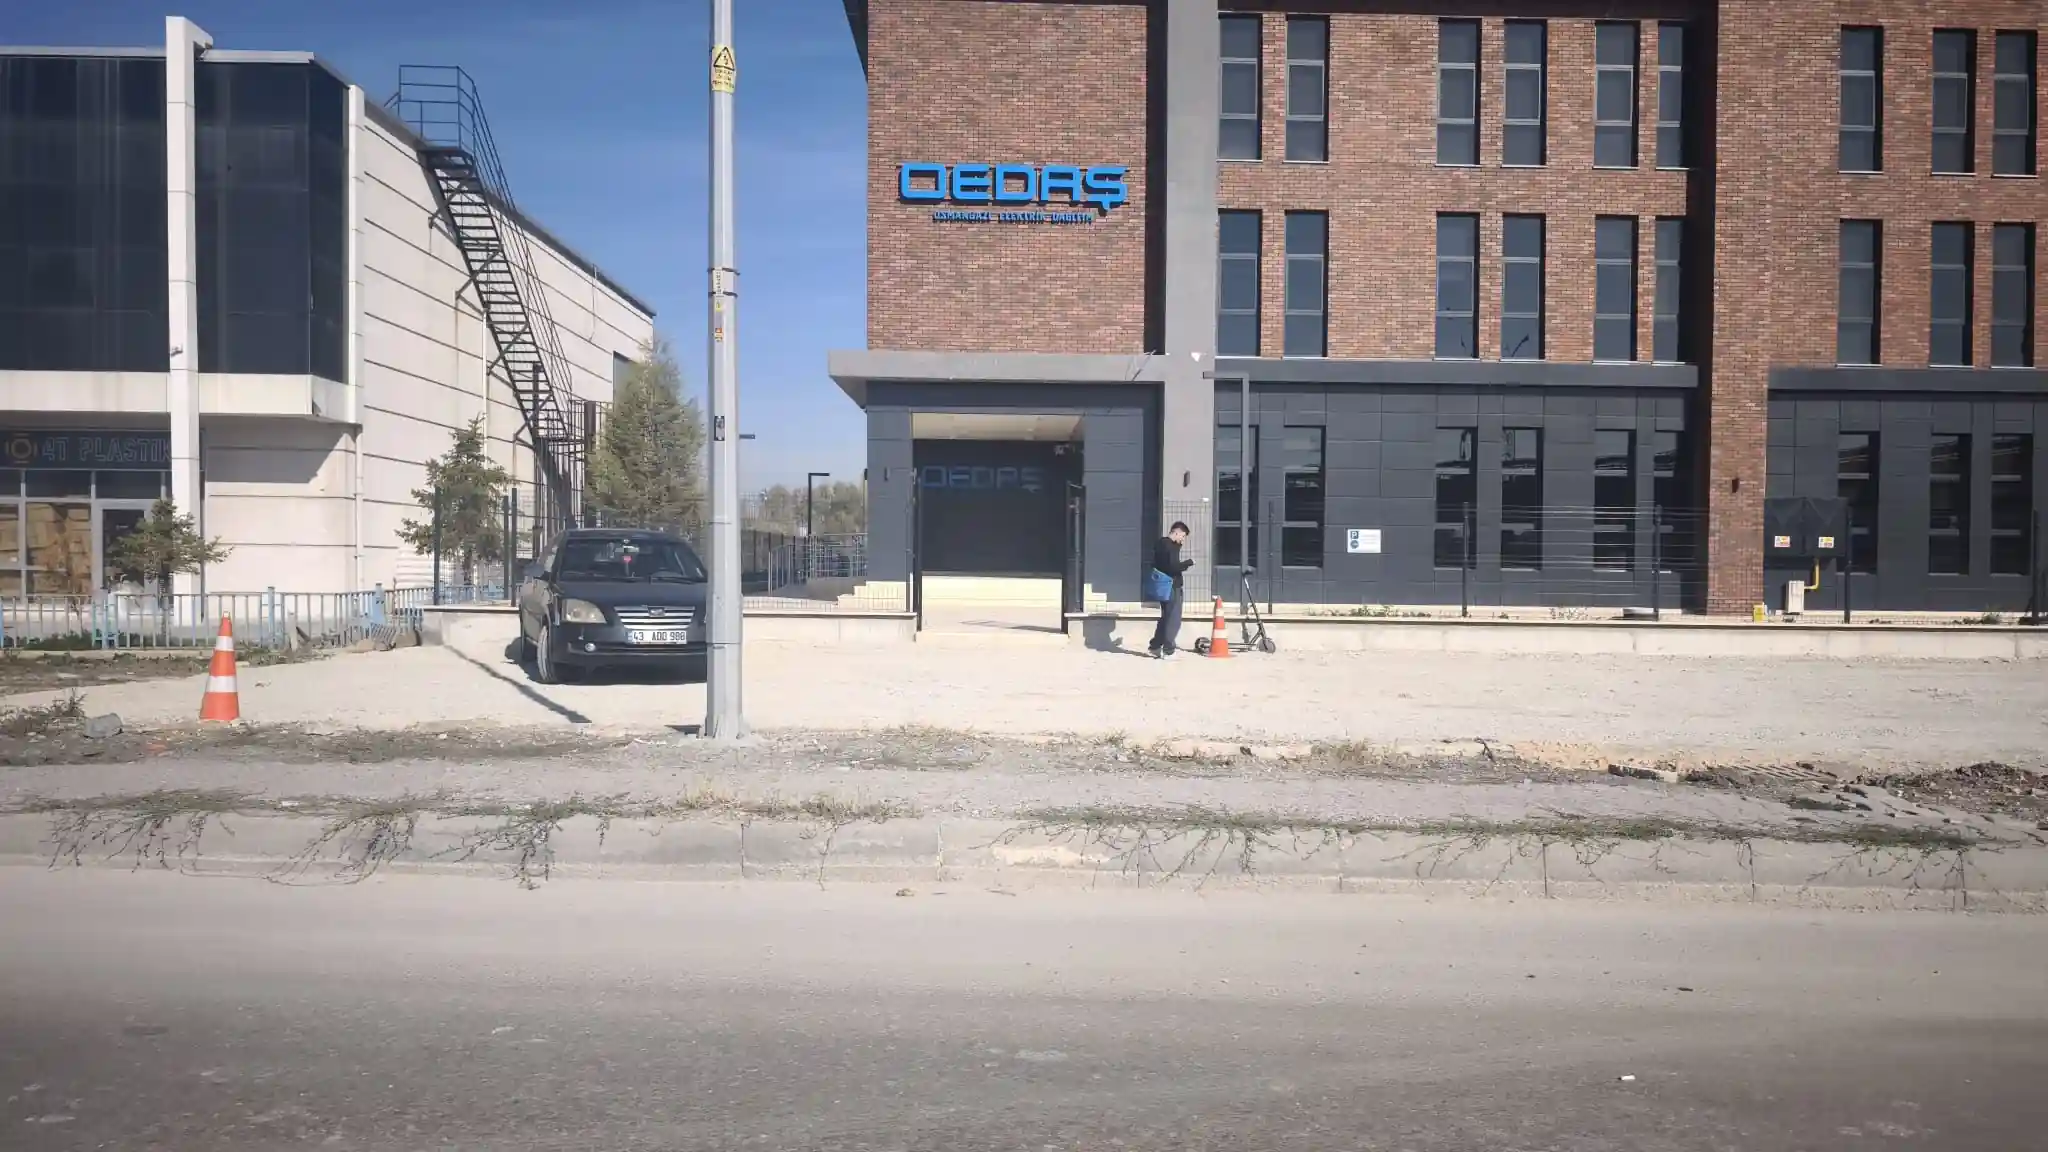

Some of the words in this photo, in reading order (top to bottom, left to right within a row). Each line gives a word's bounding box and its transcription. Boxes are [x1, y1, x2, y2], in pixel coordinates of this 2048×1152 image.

[901, 162, 1128, 211] OEDAŞ
[42, 436, 68, 462] 4T
[633, 631, 644, 641] 43
